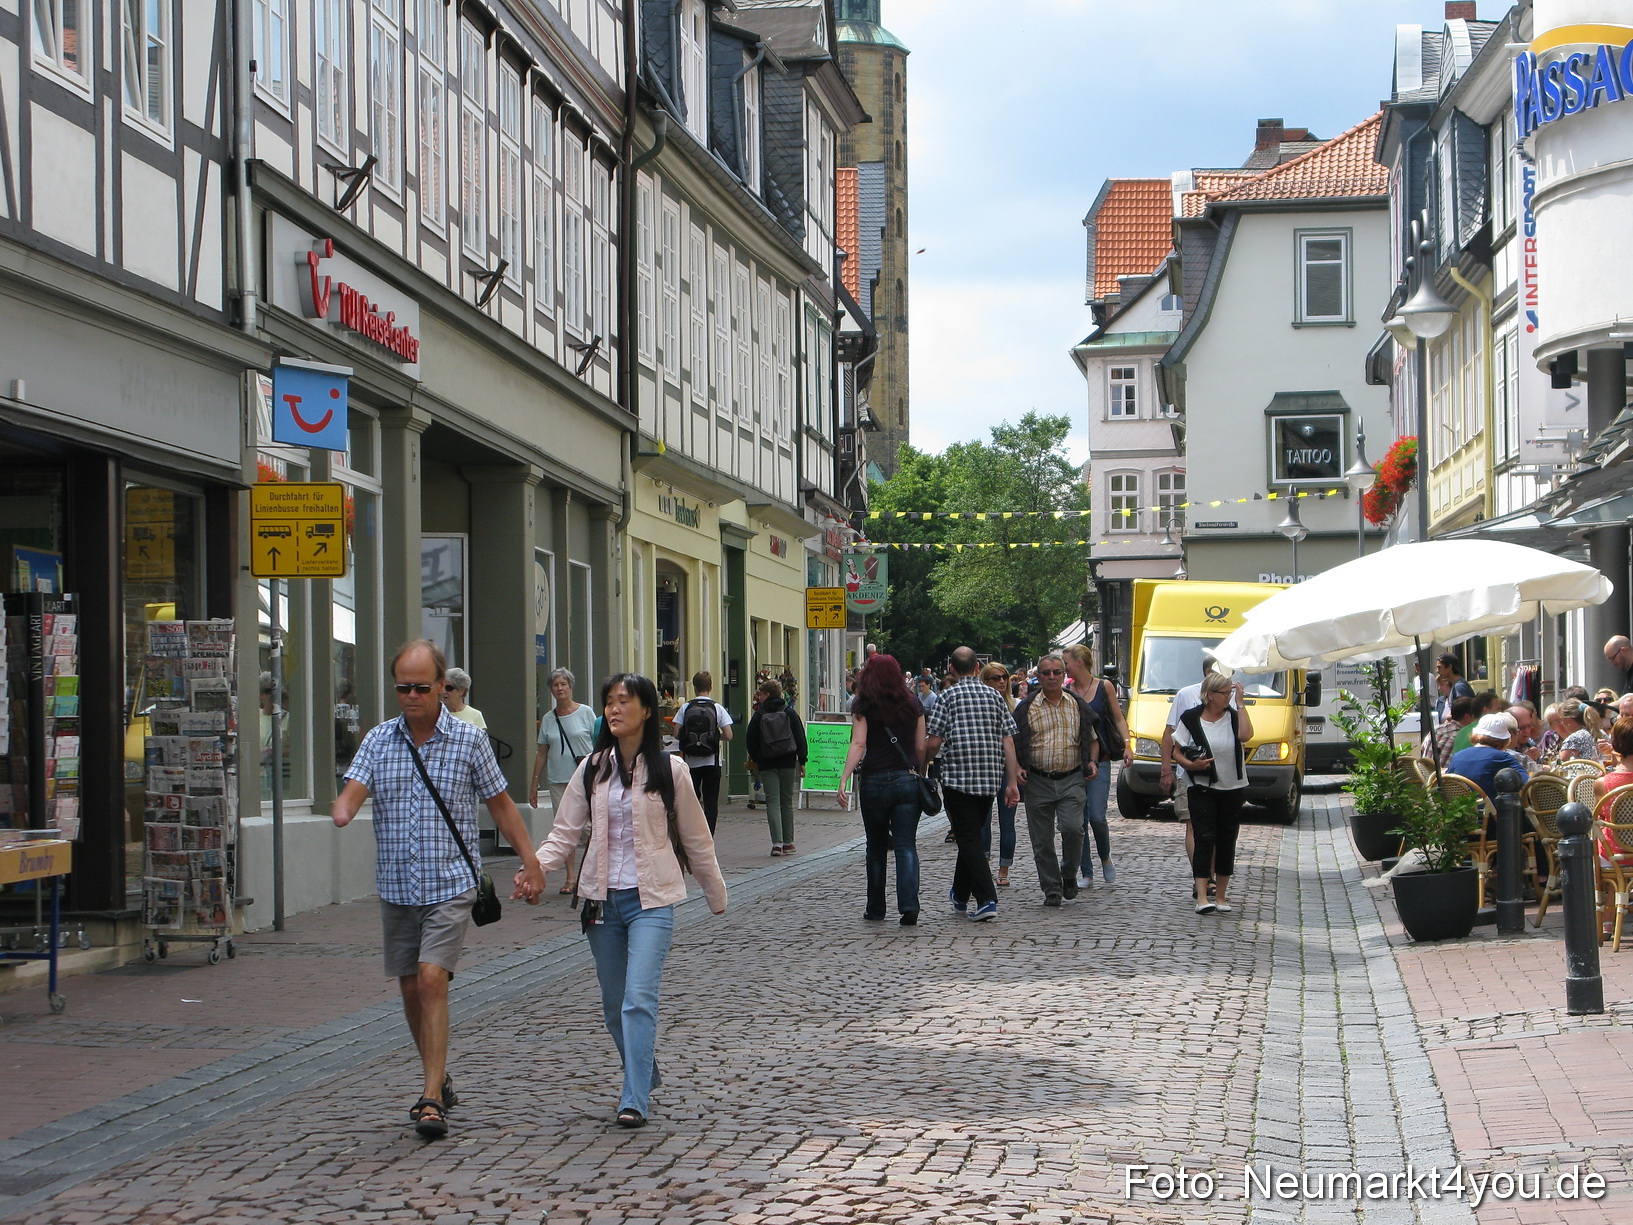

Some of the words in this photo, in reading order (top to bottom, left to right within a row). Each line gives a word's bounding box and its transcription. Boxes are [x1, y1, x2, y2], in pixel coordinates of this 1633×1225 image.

[1287, 449, 1332, 465] TATTOO
[269, 492, 309, 501] Durchfahrt
[313, 492, 324, 501] für
[255, 504, 299, 513] Linienbusse
[303, 504, 339, 513] freihalten
[18, 848, 54, 875] Brumby
